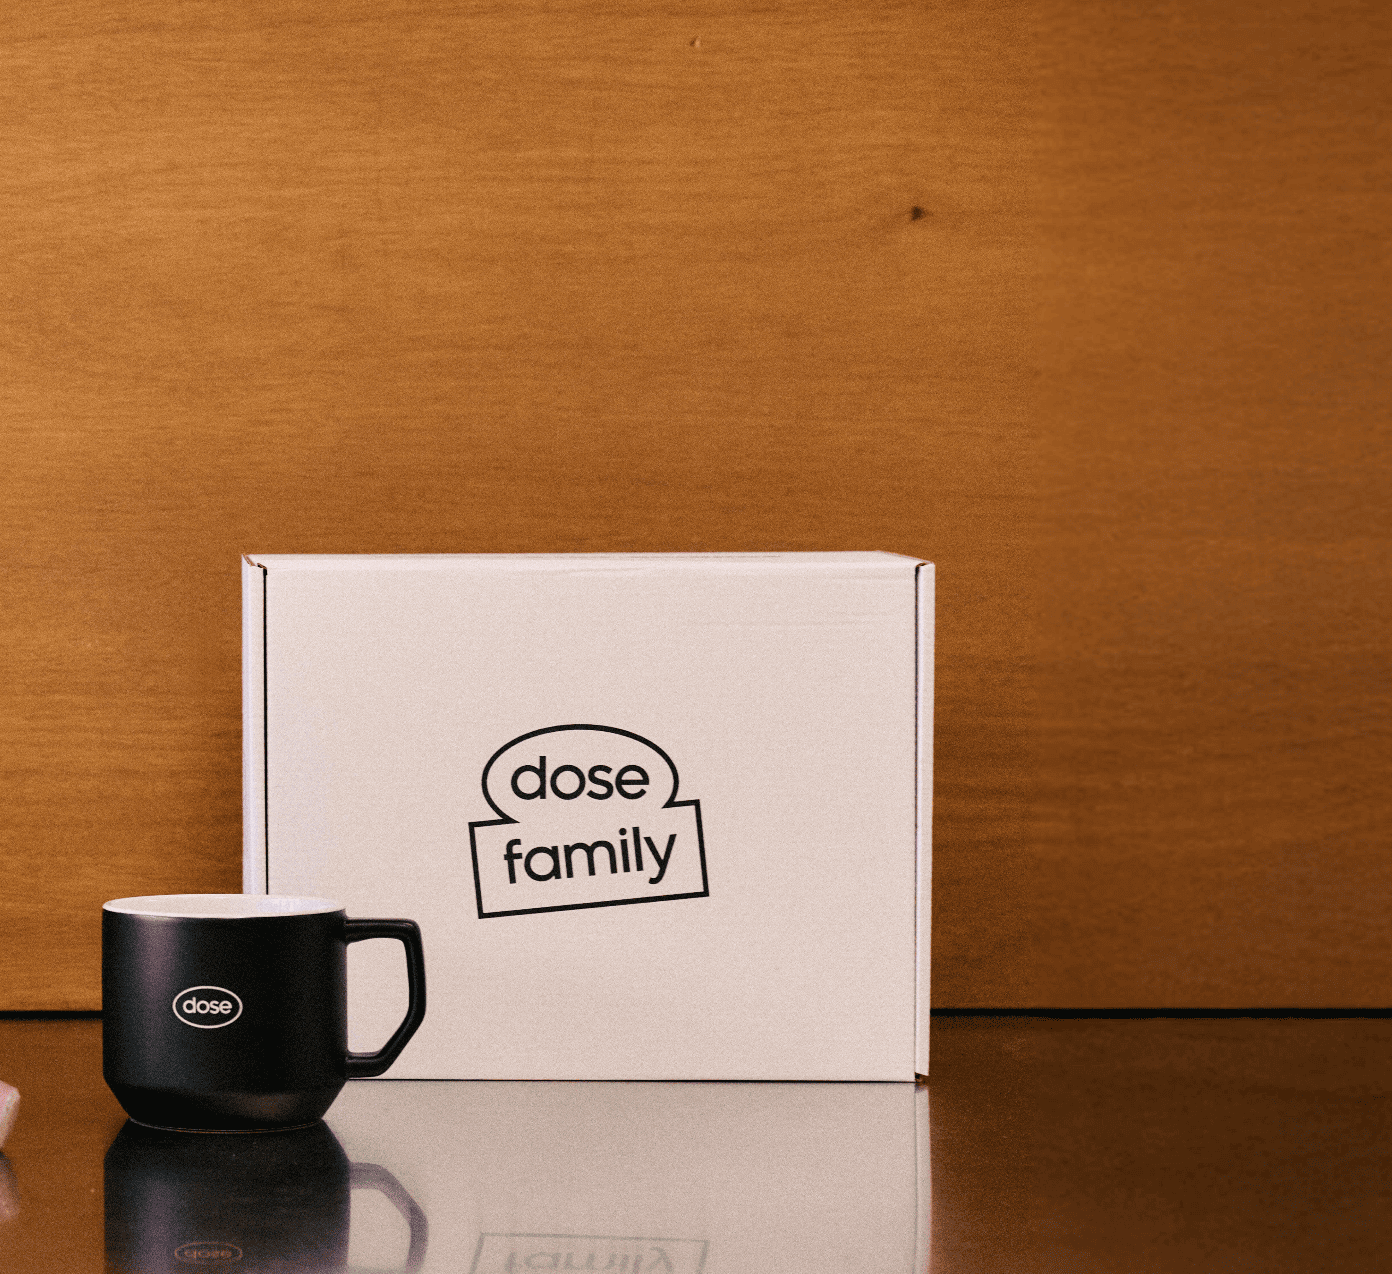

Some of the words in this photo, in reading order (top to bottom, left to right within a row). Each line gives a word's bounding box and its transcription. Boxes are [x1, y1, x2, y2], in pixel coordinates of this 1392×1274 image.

[510, 755, 650, 800] dose
[503, 826, 677, 885] family
[182, 996, 233, 1014] dose
